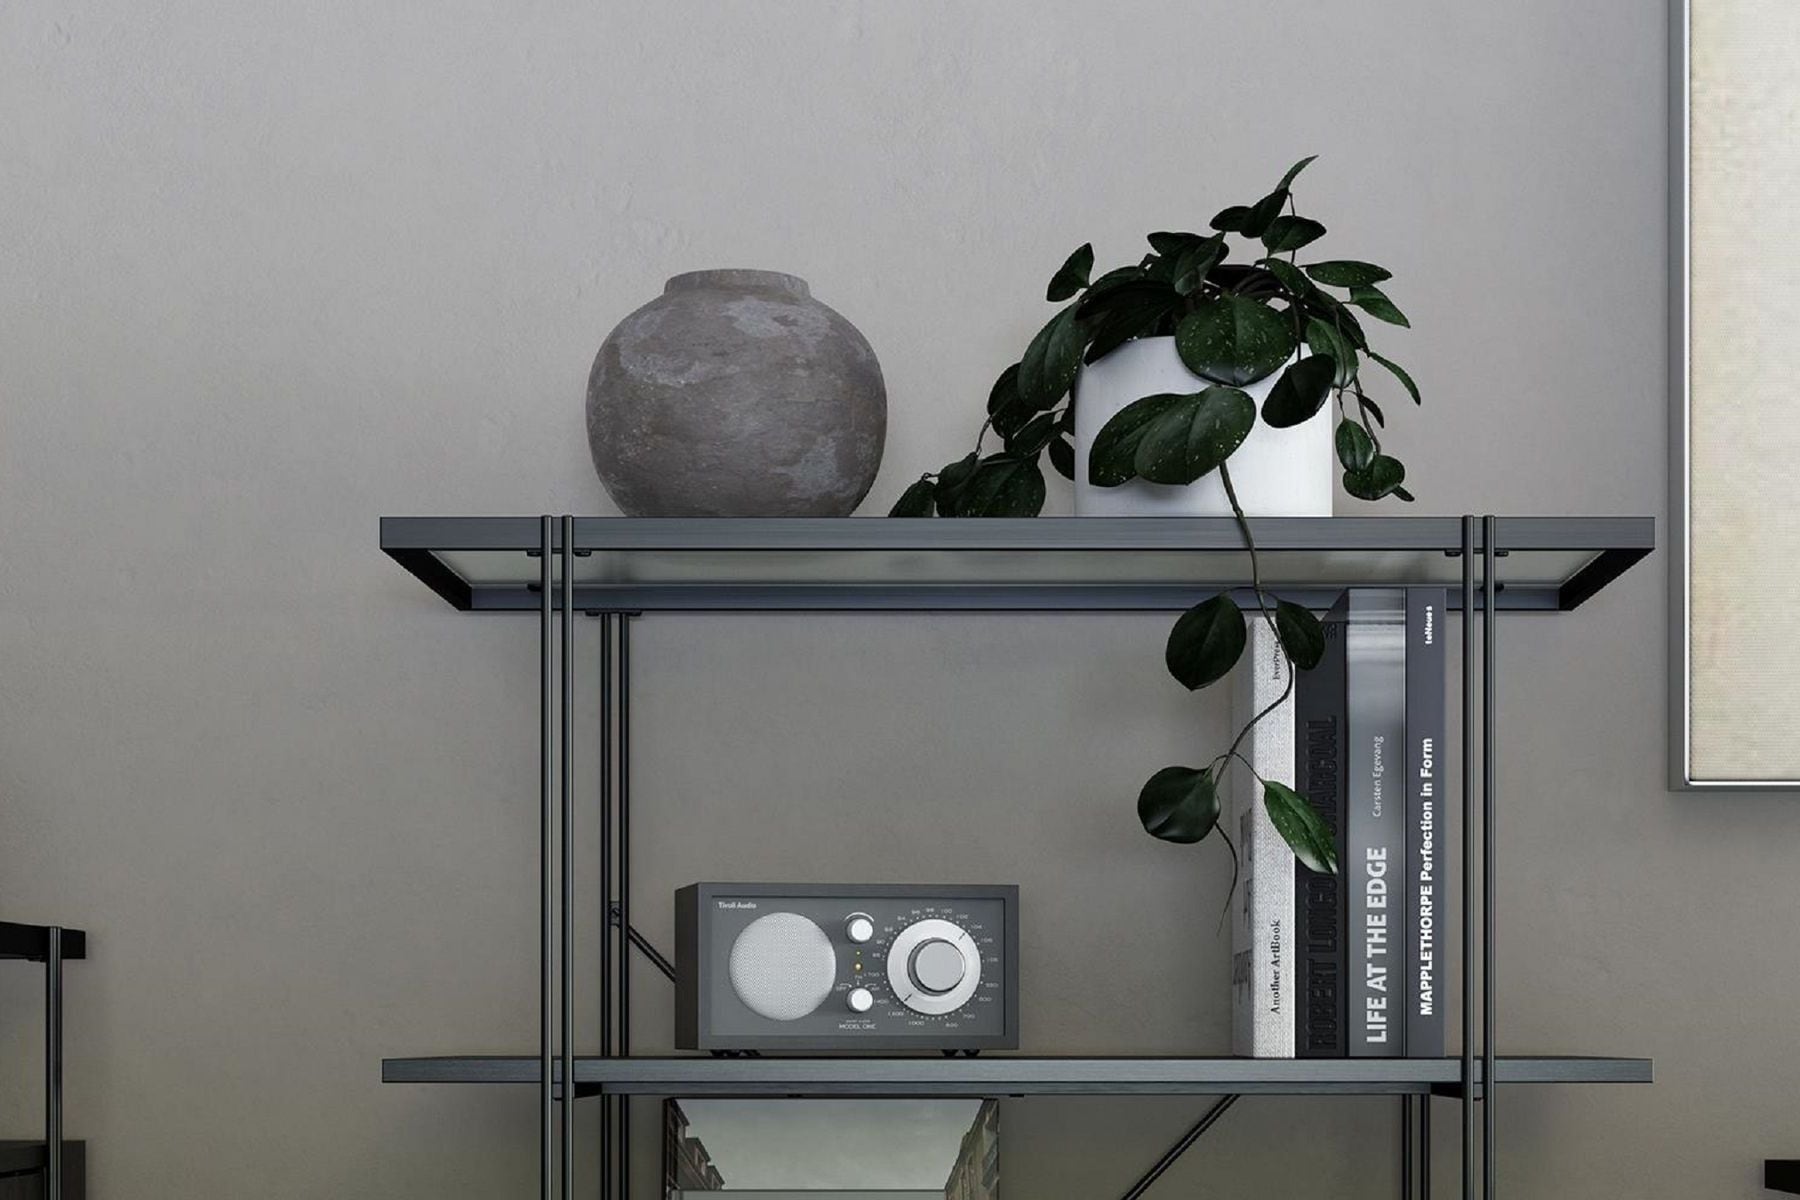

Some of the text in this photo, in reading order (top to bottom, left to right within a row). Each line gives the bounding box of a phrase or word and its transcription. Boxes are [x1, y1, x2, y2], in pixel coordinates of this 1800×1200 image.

[1372, 736, 1384, 818] Carsten Egevang
[718, 901, 757, 909] Tivoli Audio
[1306, 876, 1337, 953] LONGO
[1420, 738, 1433, 1016] MAPPLETHORPE Perfection in Form
[1270, 919, 1281, 1014] Another ArtBook
[1367, 847, 1387, 1043] LIFE AT THE EDGE
[1306, 958, 1337, 1050] ROBERT
